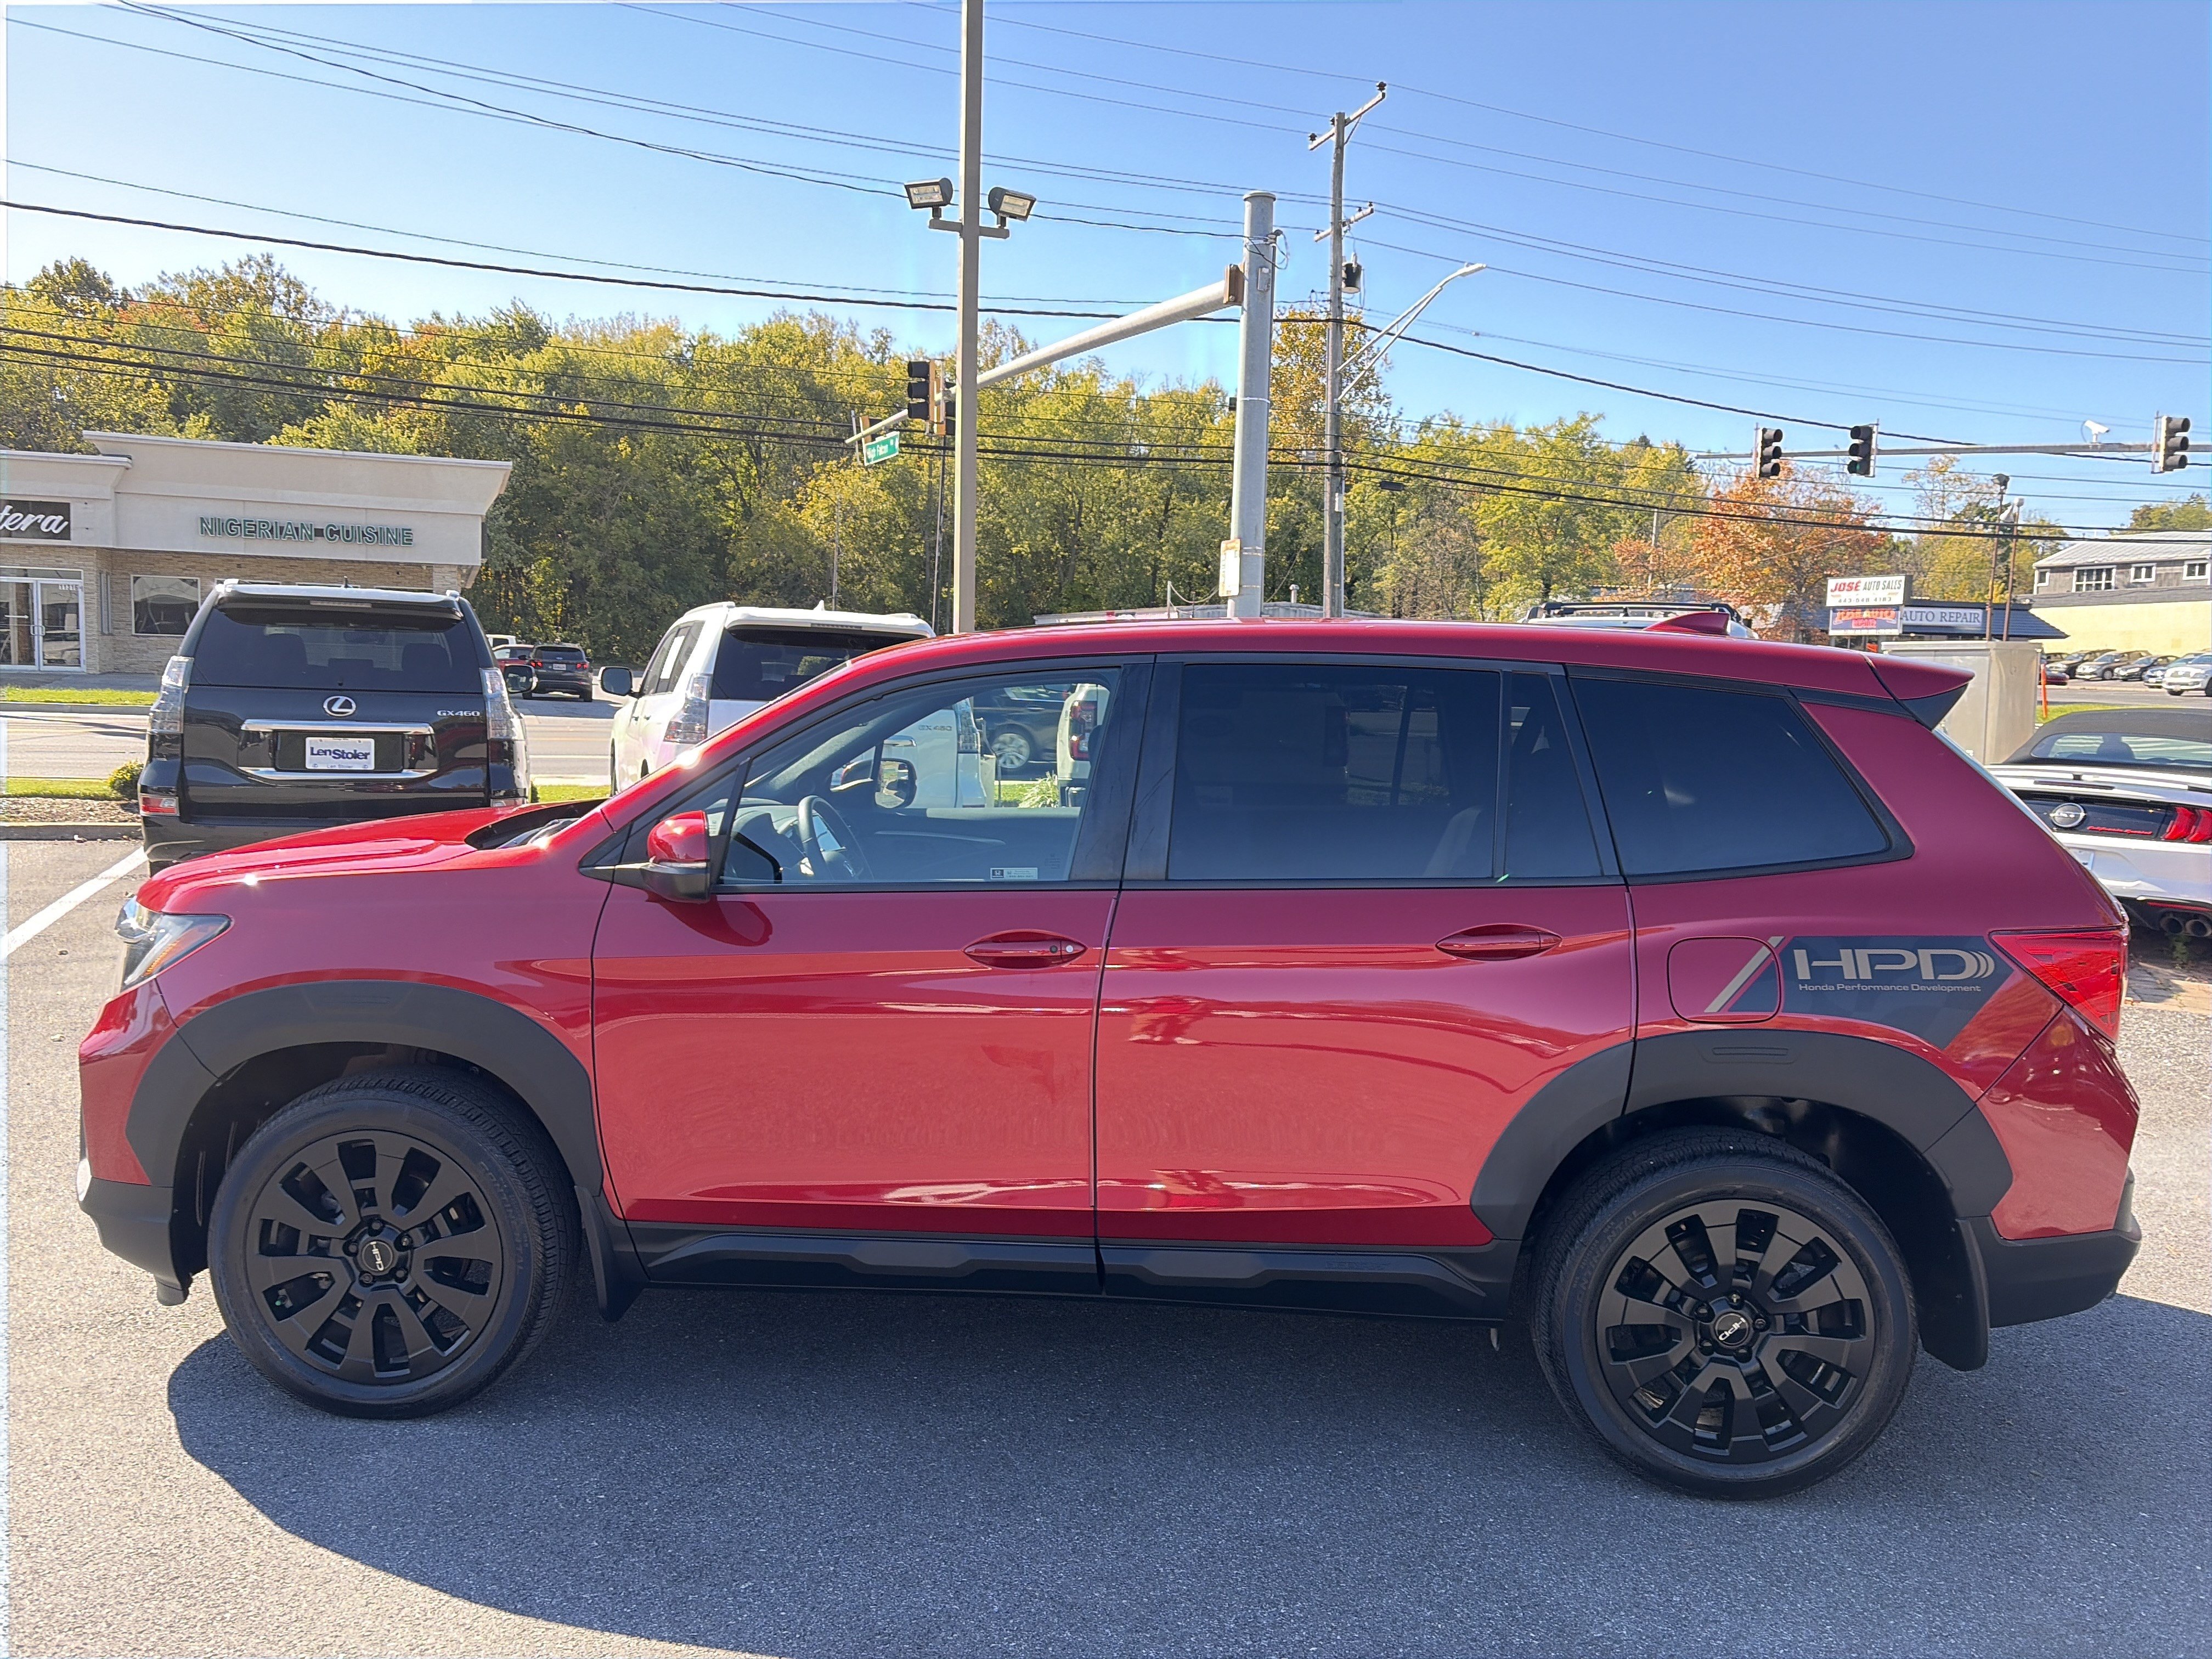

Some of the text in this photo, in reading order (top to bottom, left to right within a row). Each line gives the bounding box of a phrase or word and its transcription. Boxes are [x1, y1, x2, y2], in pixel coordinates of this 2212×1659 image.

[199, 516, 414, 546] NIGERIAN CUISINE
[1830, 579, 1903, 592] JOSÉ AUTO SALES
[1902, 611, 1980, 623] AUTO REPAIR
[1793, 949, 1995, 980] HPD
[1911, 984, 1982, 992] Development
[370, 1241, 385, 1271] HPD
[1718, 1317, 1746, 1341] HPD
